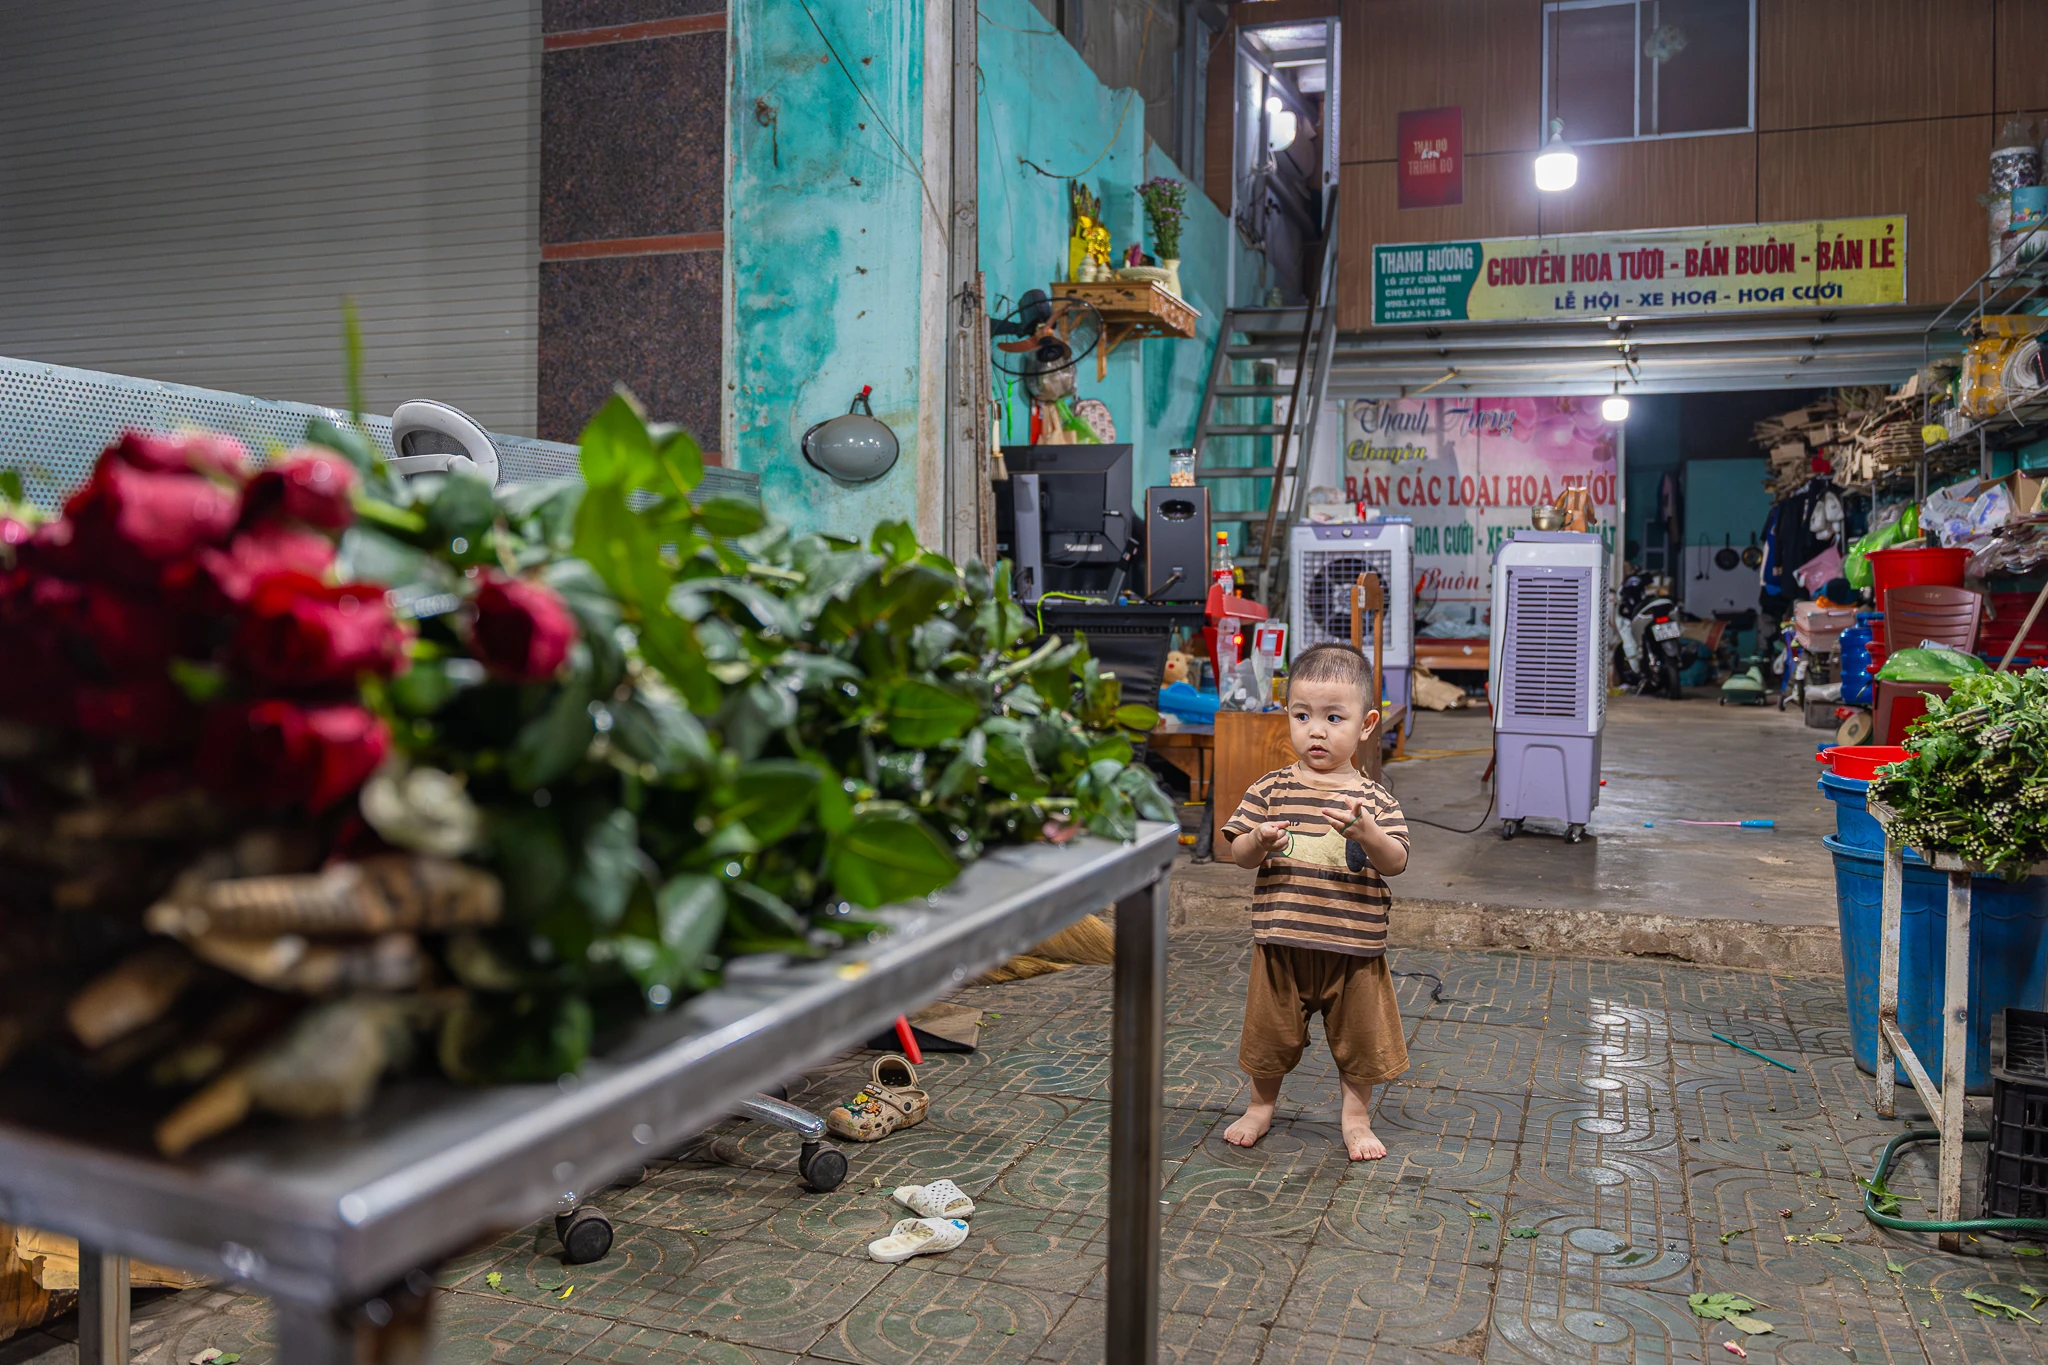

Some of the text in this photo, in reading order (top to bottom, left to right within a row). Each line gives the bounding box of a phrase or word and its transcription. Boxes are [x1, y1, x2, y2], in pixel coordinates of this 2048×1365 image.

[1379, 246, 1474, 274] THANH HƯƠNG
[1487, 249, 1565, 287] CHUYÊN
[1571, 252, 1613, 283] HOA
[1618, 247, 1664, 280] TƯƠI
[1685, 240, 1729, 277] BÁN
[1735, 236, 1795, 275] BUÔN
[1817, 233, 1863, 272] BÁN
[1870, 224, 1895, 268] LẺ
[1439, 274, 1462, 283] NAM
[1554, 291, 1576, 310] LỄ
[1583, 291, 1619, 311] HỘI
[1639, 291, 1664, 307] XE
[1672, 290, 1717, 307] HOA
[1738, 287, 1785, 304] HOA
[1792, 281, 1843, 300] CƯỚI
[1354, 399, 1429, 436] Thanh
[1348, 439, 1428, 464] Chuyên
[1345, 467, 1391, 506] BÁN
[1397, 466, 1441, 506] CÁC
[1447, 475, 1500, 515] LOẠI
[1506, 475, 1556, 506] HOA
[1415, 526, 1440, 555] HOA
[1444, 520, 1473, 555] CƯỚI
